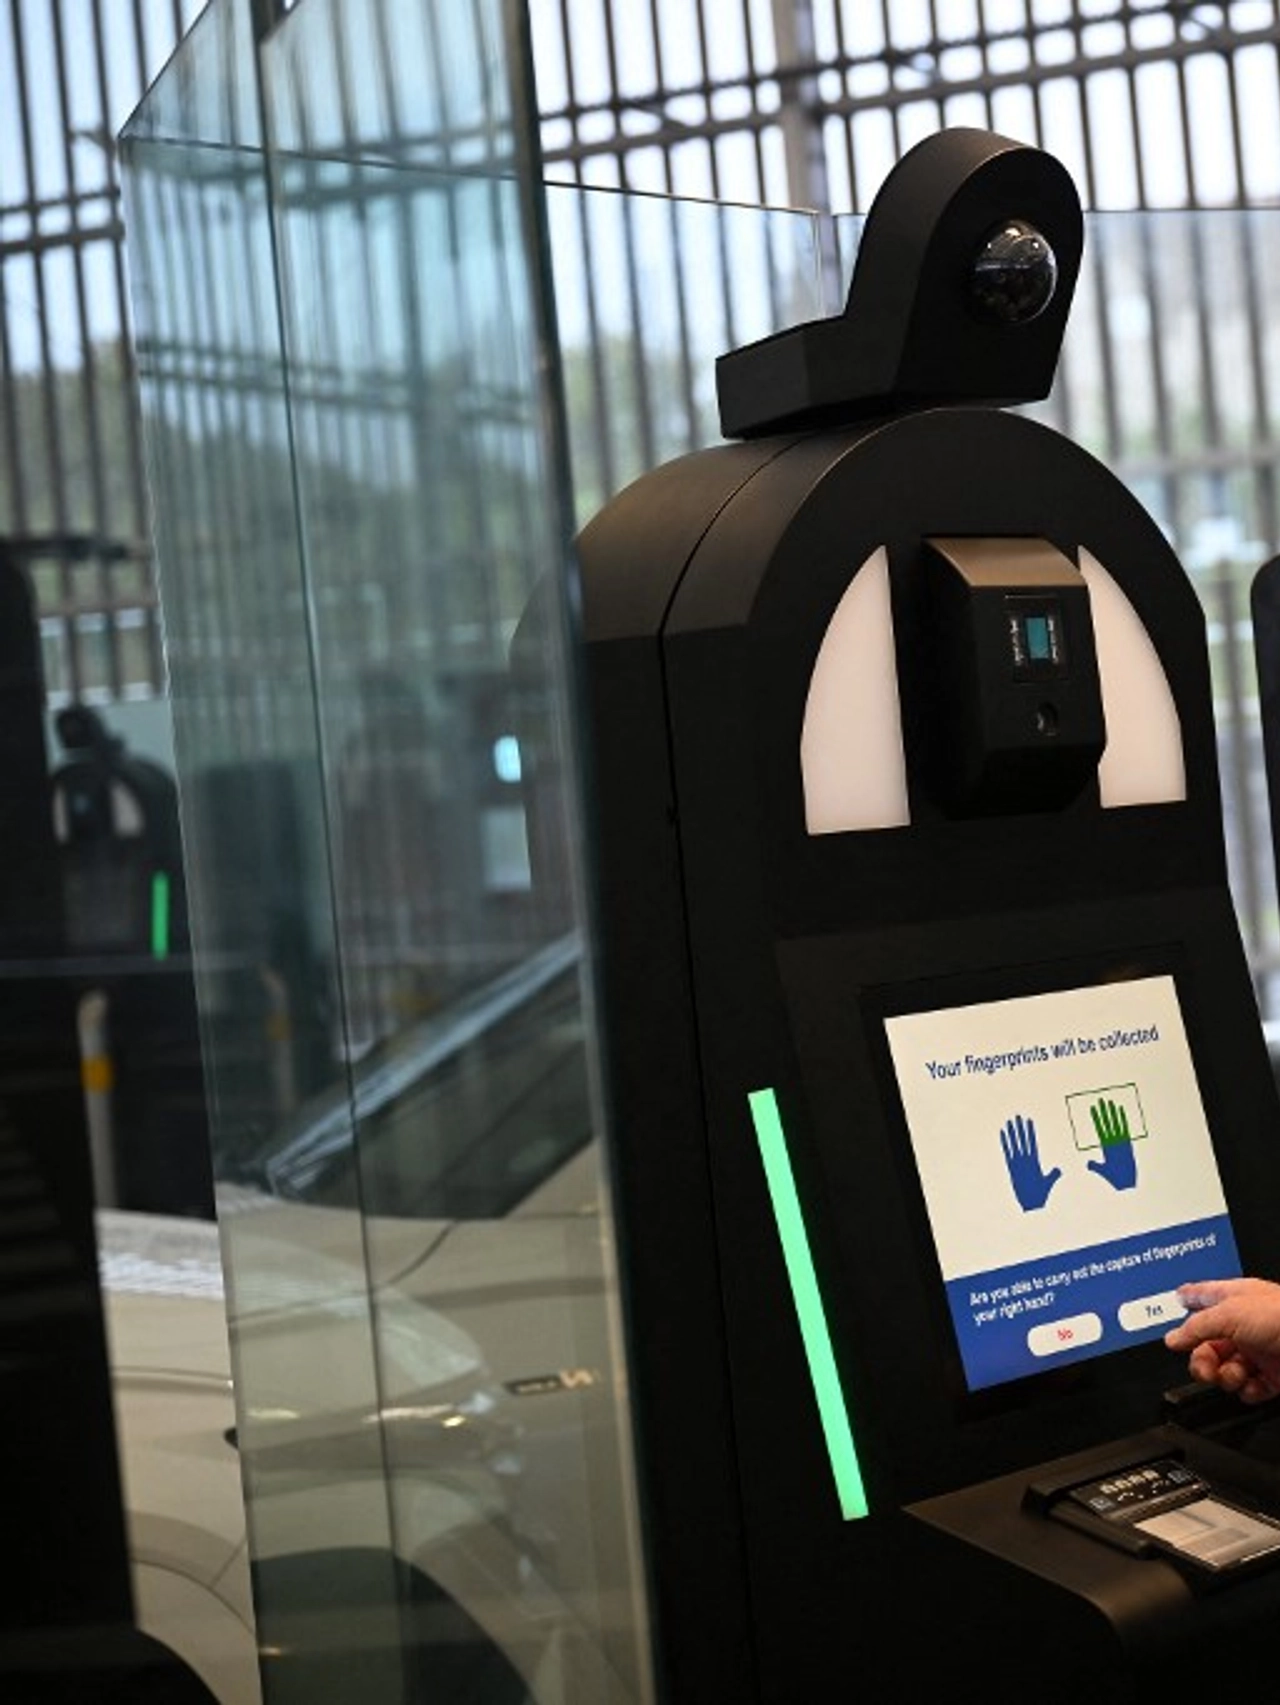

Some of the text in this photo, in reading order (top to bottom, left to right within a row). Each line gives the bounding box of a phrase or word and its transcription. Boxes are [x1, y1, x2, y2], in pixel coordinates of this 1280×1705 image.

[925, 1025, 1160, 1079] Your fingerprints will be collected
[970, 1233, 1217, 1306] Are you able to carry out the capture of fingerprints of
[973, 1308, 997, 1327] your
[1000, 1300, 1023, 1319] right
[1145, 1305, 1164, 1318] Yes
[1057, 1329, 1073, 1341] No
